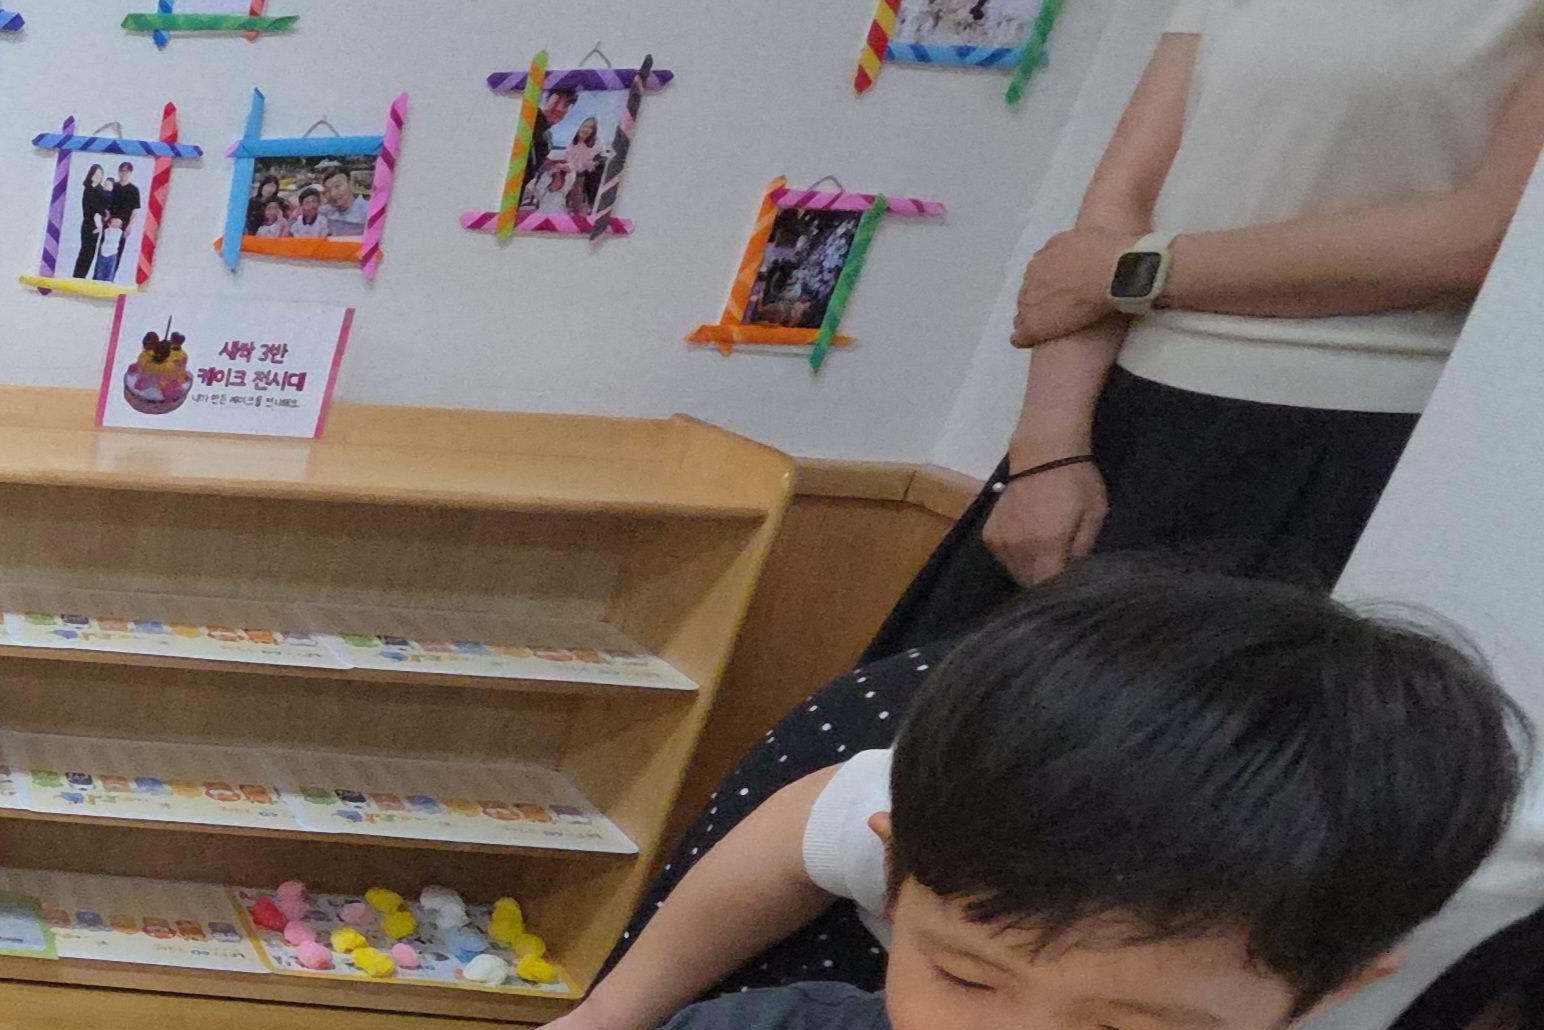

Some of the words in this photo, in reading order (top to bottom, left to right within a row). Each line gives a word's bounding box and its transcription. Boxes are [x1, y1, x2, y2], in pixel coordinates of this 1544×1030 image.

[257, 343, 289, 364] 3반
[197, 366, 247, 387] 케이크
[252, 369, 307, 391] 전시대
